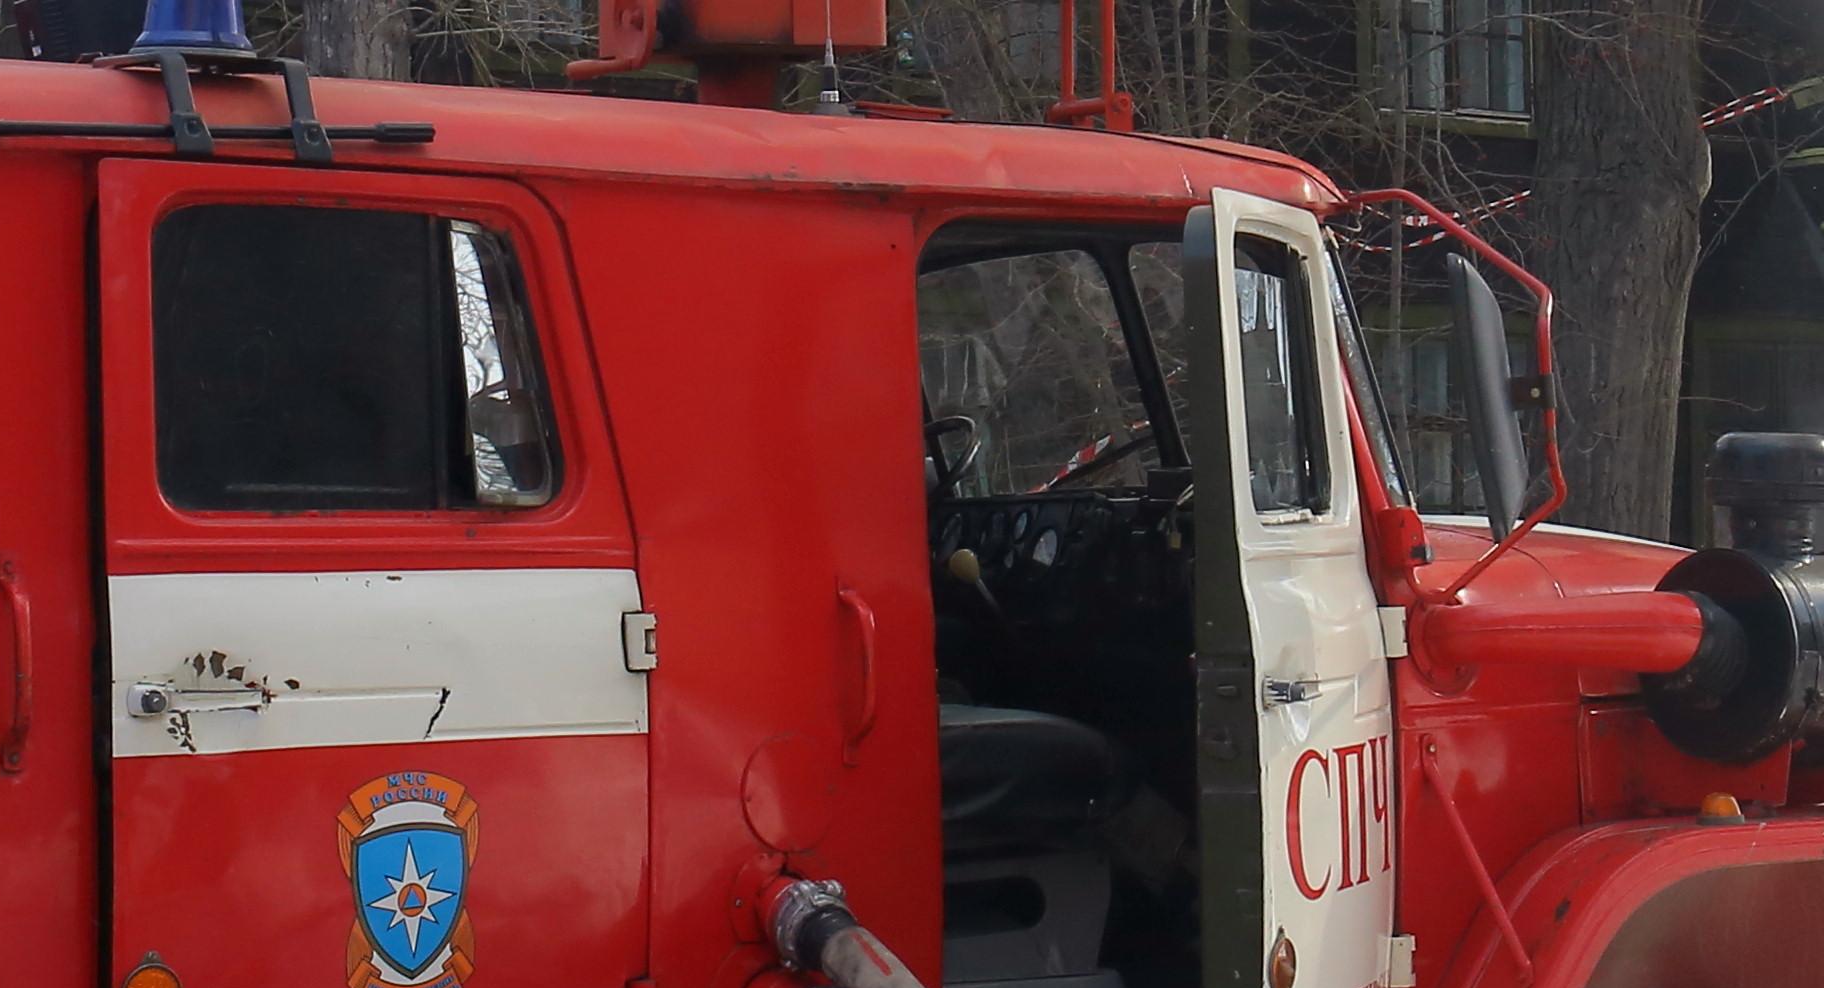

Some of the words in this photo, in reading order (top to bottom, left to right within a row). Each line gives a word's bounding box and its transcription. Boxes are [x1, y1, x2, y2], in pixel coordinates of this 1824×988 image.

[388, 772, 426, 787] МЧС
[371, 788, 447, 807] РОССИИ
[1286, 735, 1391, 900] СПЧ
